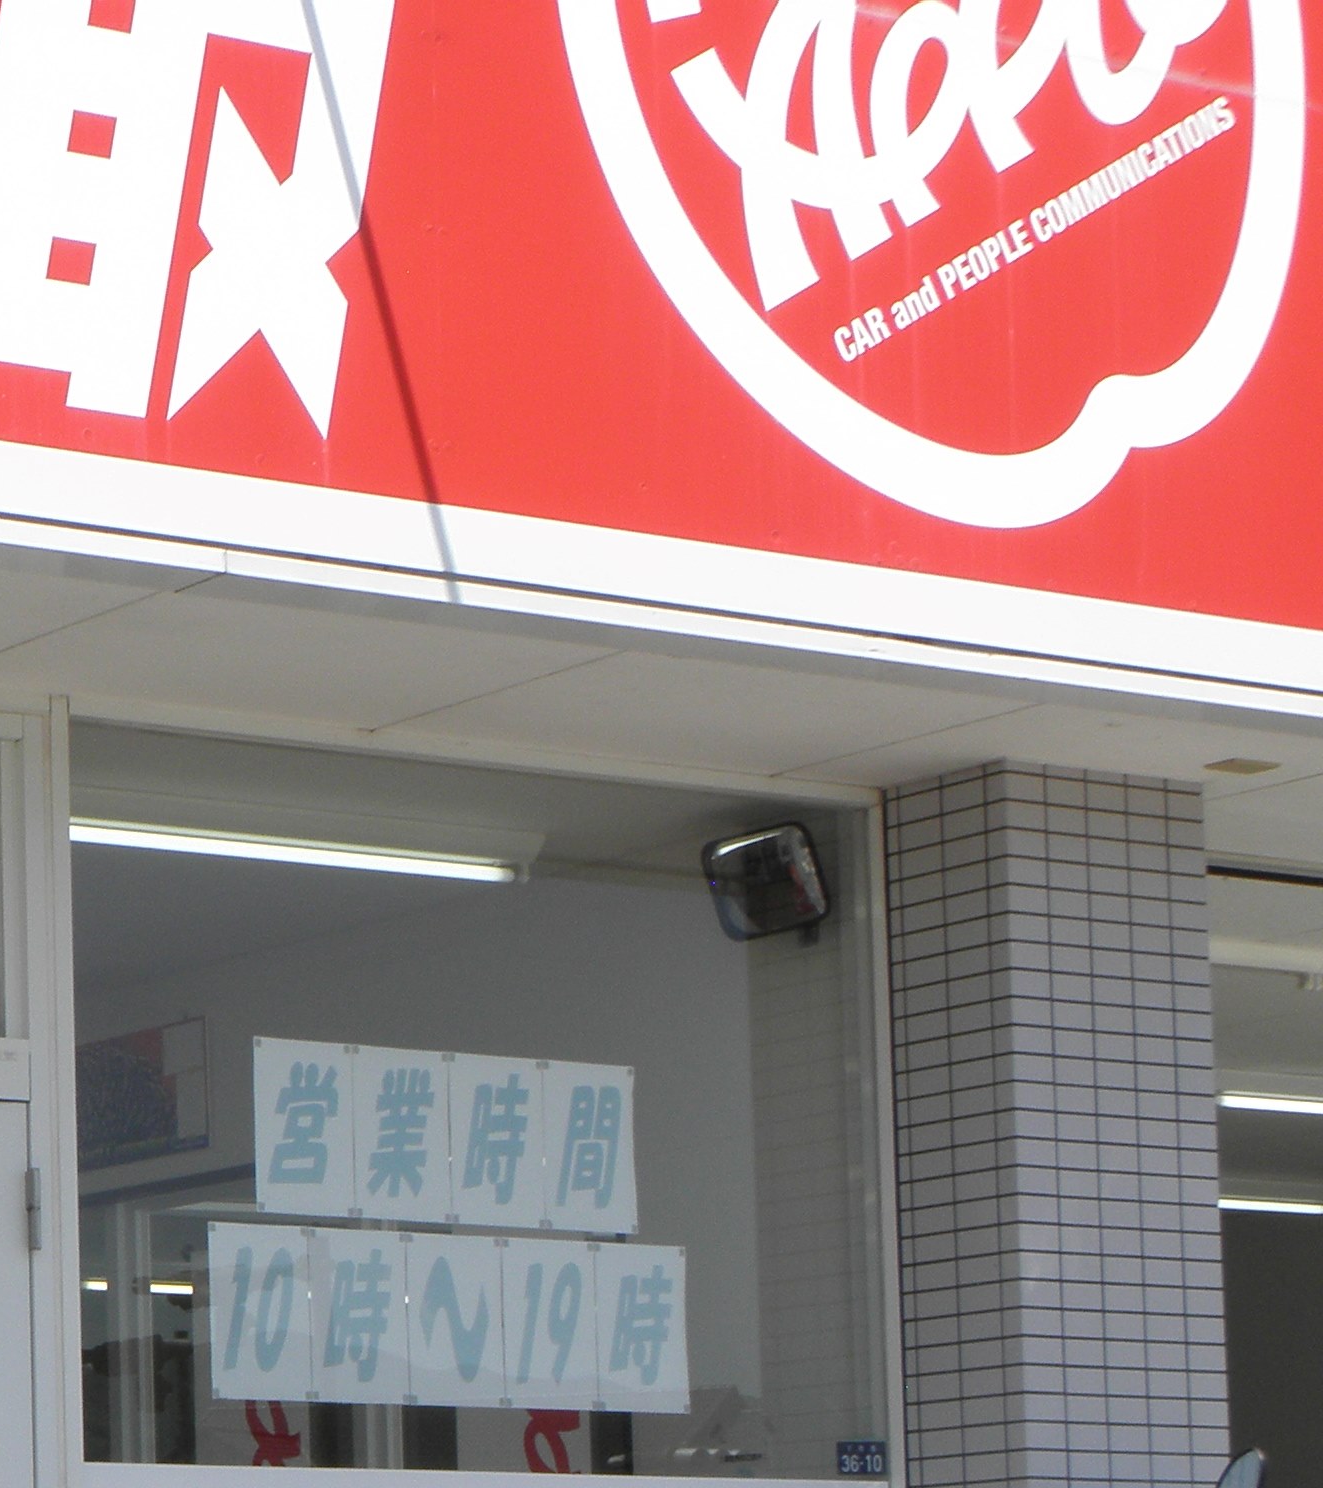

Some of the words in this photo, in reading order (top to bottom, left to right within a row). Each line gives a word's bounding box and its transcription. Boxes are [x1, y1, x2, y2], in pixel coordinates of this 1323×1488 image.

[833, 307, 891, 363] CAR
[891, 275, 941, 330] and
[937, 225, 1034, 303] PEOPLE
[1031, 96, 1237, 244] COMMUNICATIONS
[268, 1061, 622, 1210] 営業時間
[841, 1454, 883, 1473] 36-10
